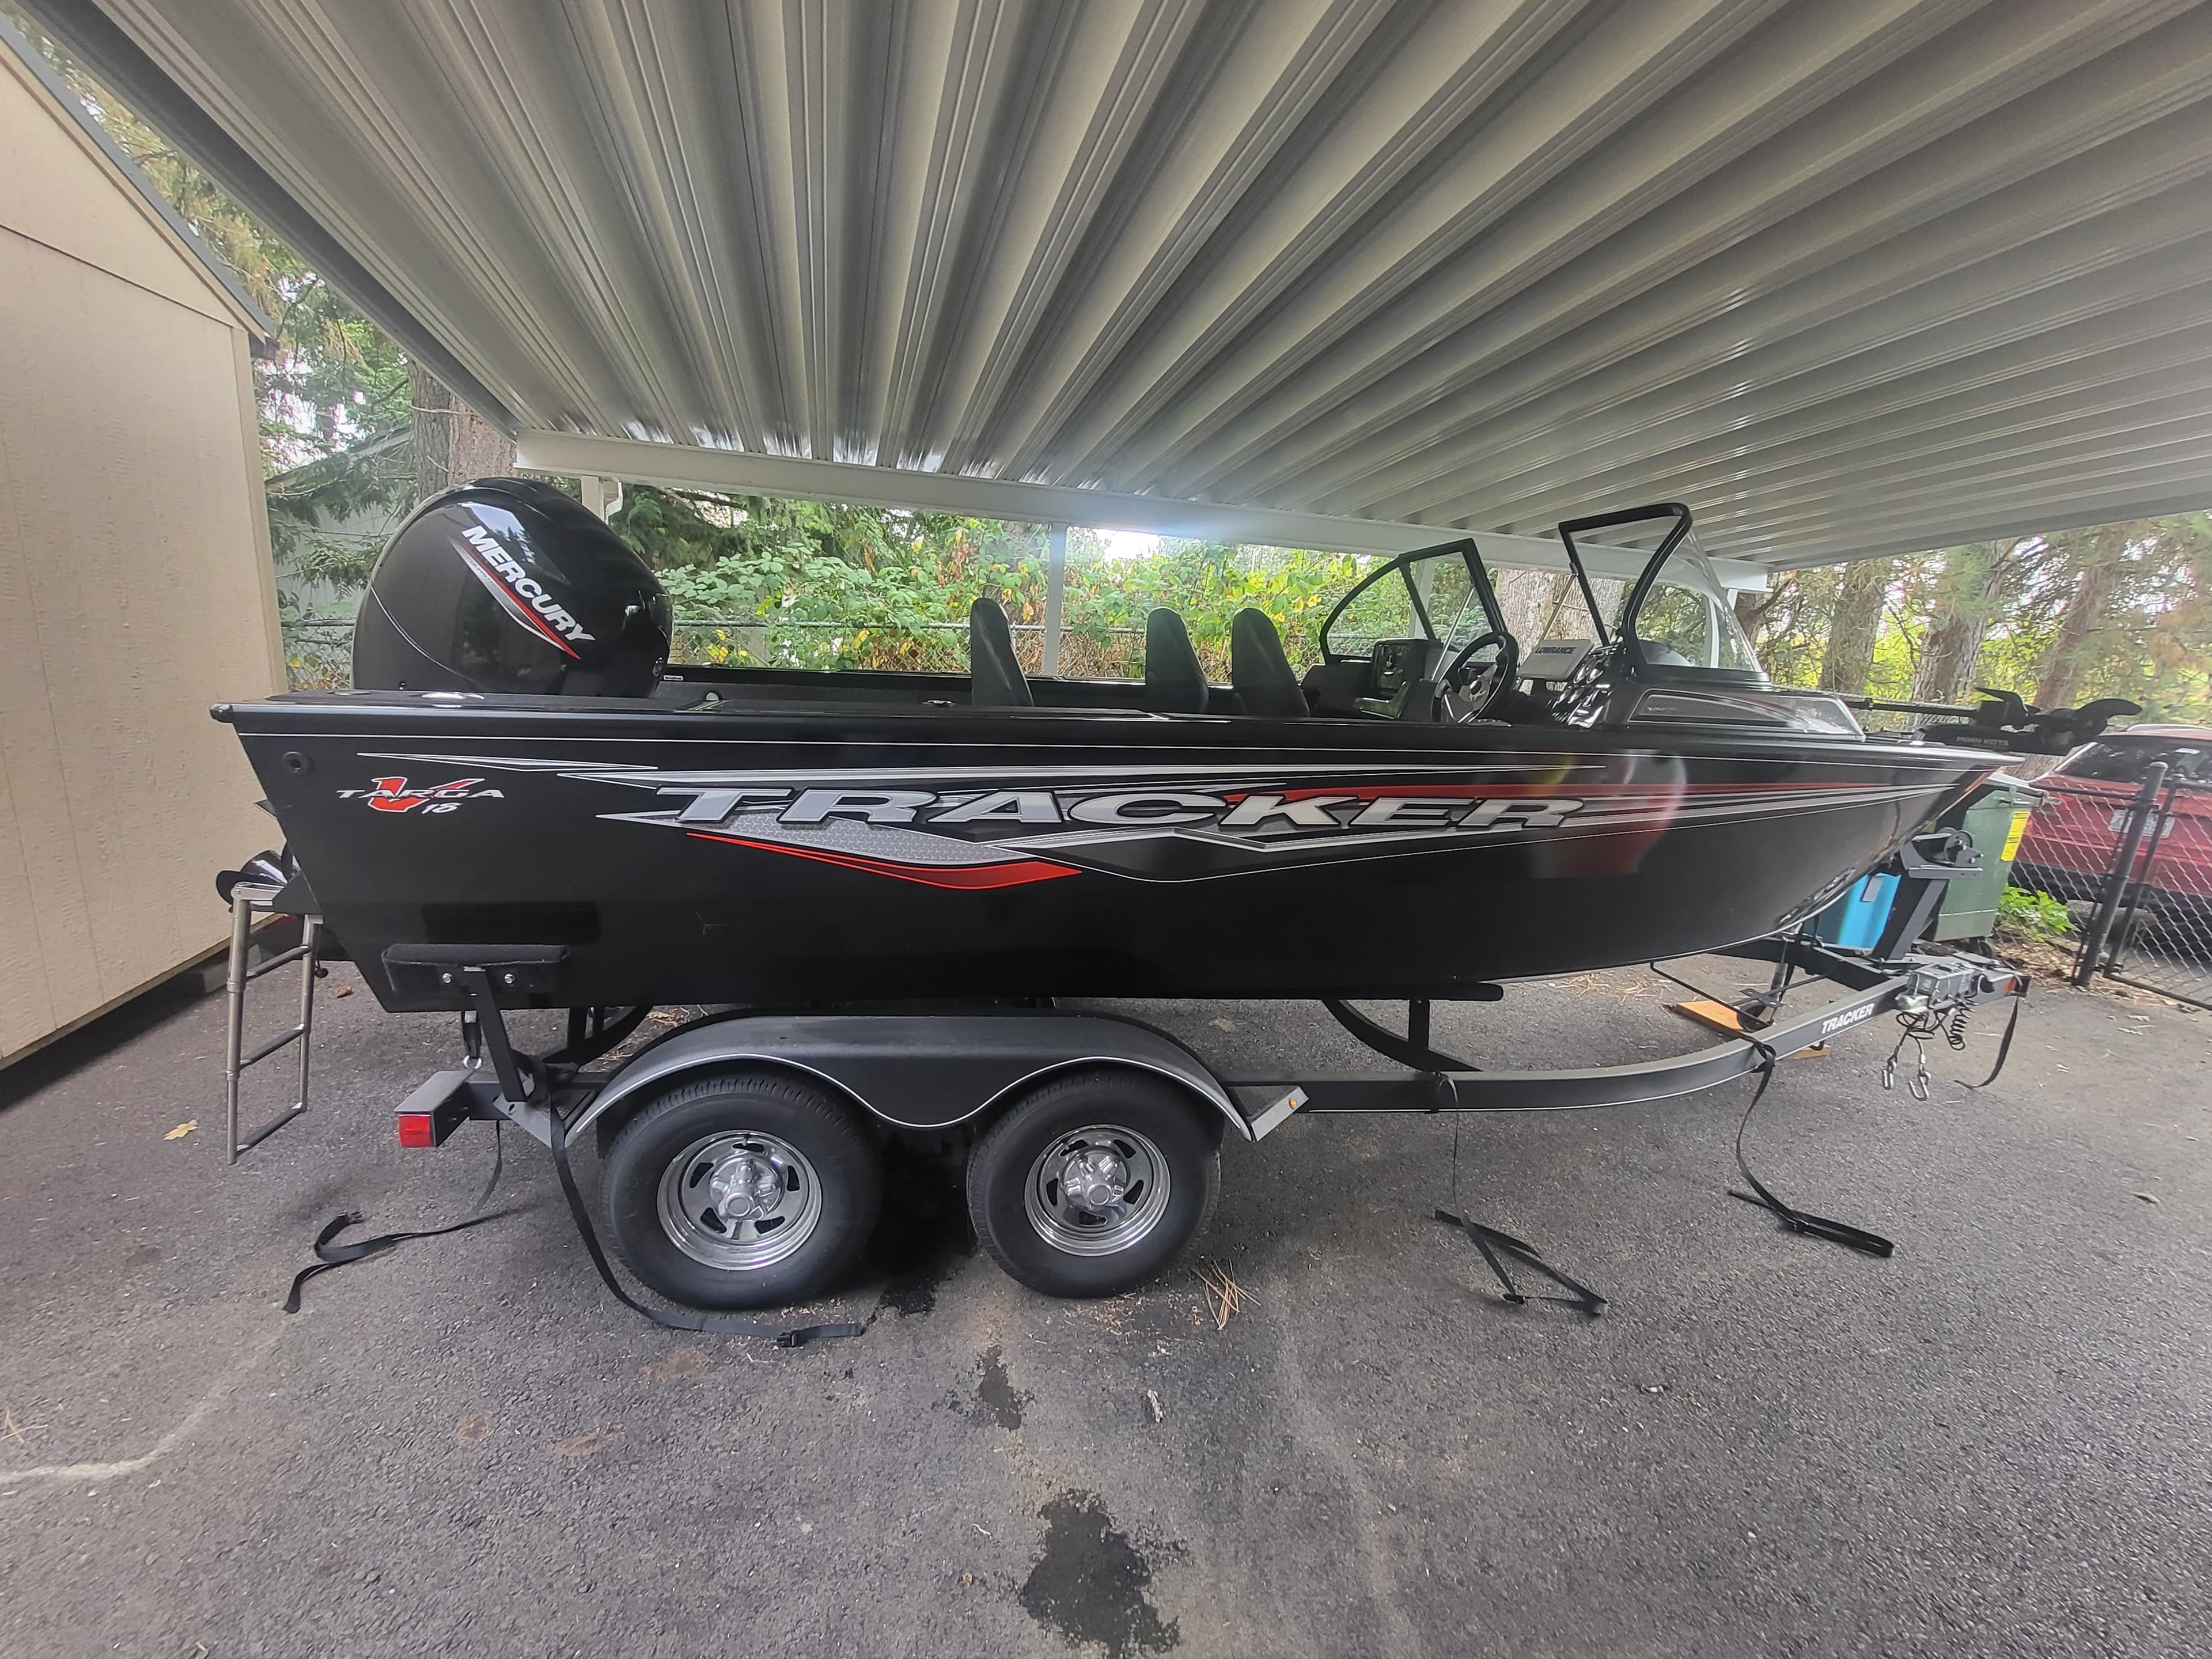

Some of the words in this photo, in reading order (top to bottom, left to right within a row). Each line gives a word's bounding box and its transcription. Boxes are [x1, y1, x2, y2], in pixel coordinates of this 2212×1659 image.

[461, 525, 596, 642] MERCURY
[1534, 646, 1577, 654] LOWRANCE
[336, 789, 505, 799] TARGA
[422, 802, 464, 815] 18
[656, 786, 1585, 830] TRACKER
[1821, 1002, 1875, 1035] TRACKER
